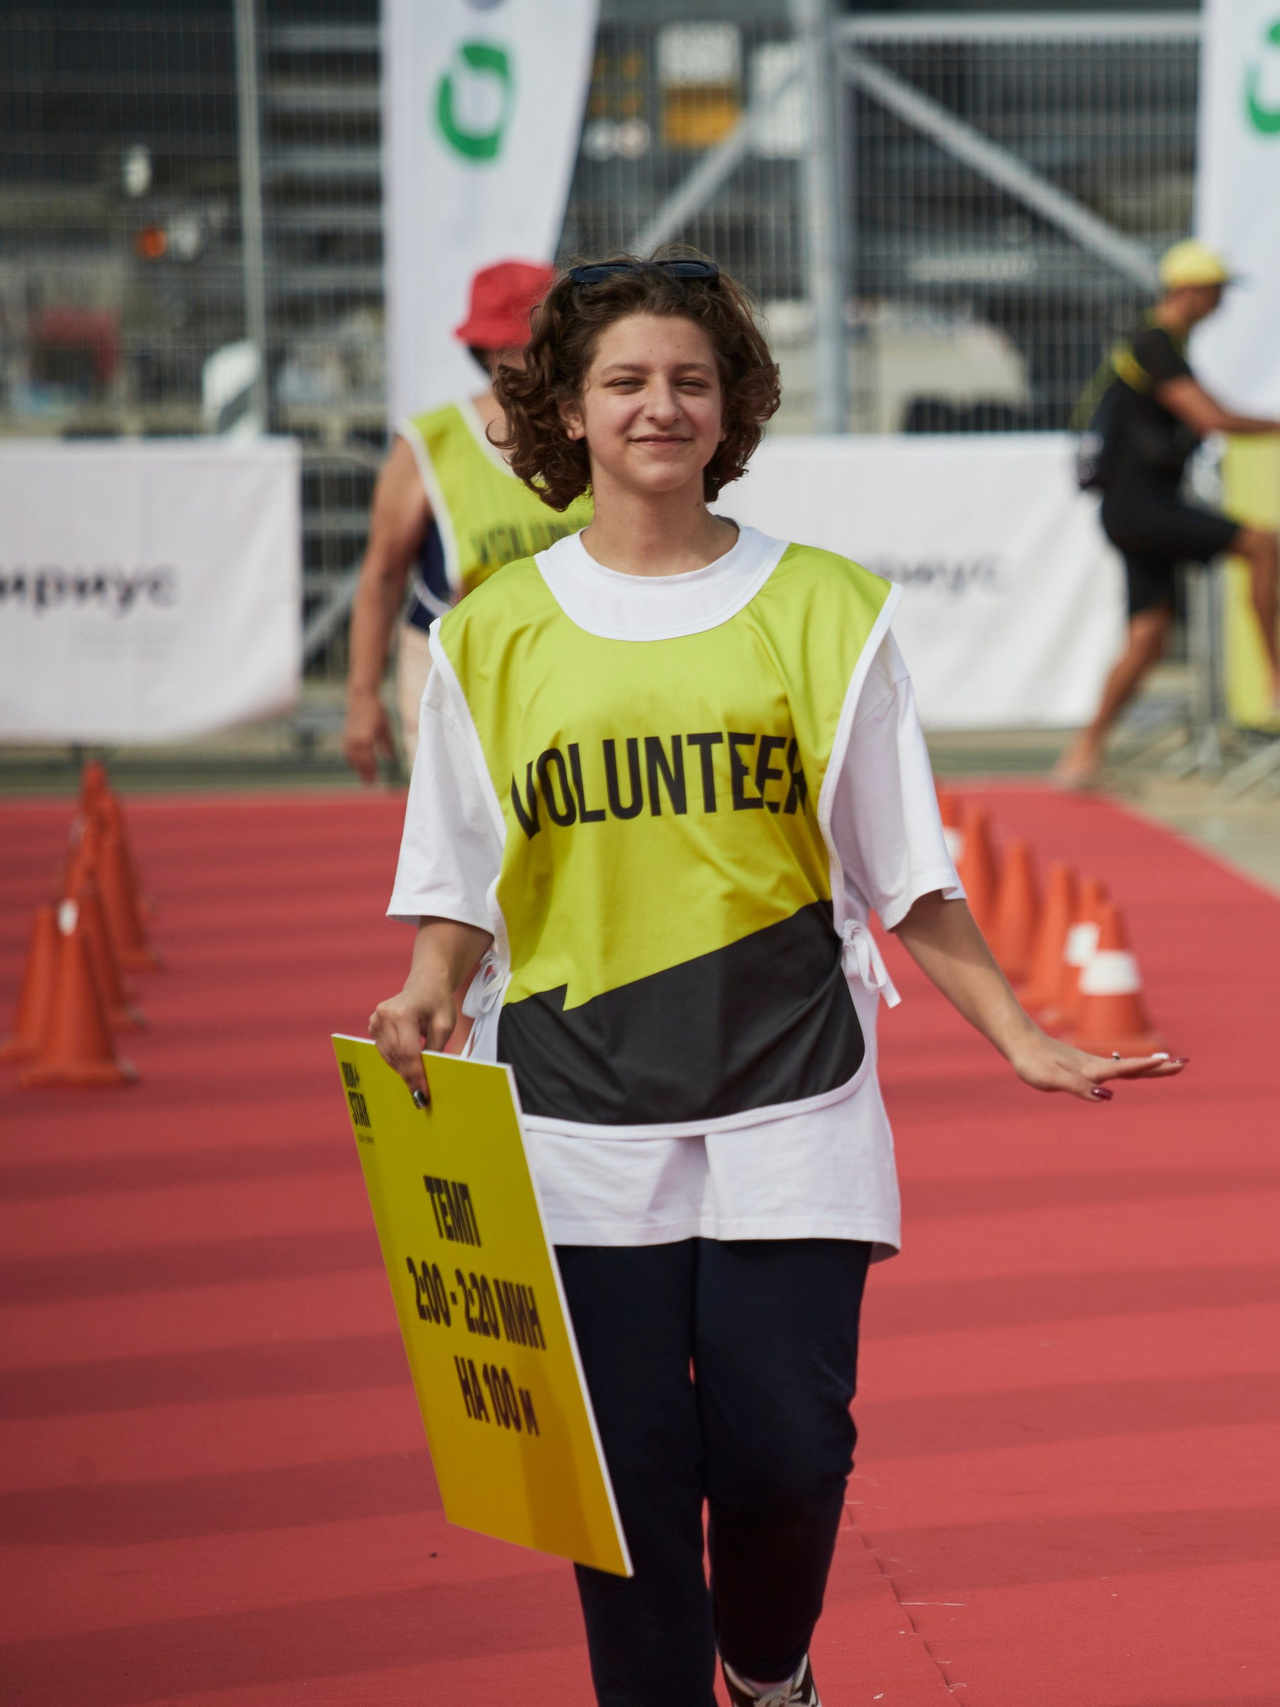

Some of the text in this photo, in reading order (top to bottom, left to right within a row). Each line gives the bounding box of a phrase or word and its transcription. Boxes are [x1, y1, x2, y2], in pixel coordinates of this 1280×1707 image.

[348, 1090, 371, 1128] STAR
[423, 1174, 482, 1248] ТЕМП
[406, 1256, 451, 1328] 2:00
[455, 1269, 500, 1341] 2:20
[493, 1278, 546, 1351] МИН
[454, 1354, 490, 1424] НА
[482, 1362, 522, 1433] 100
